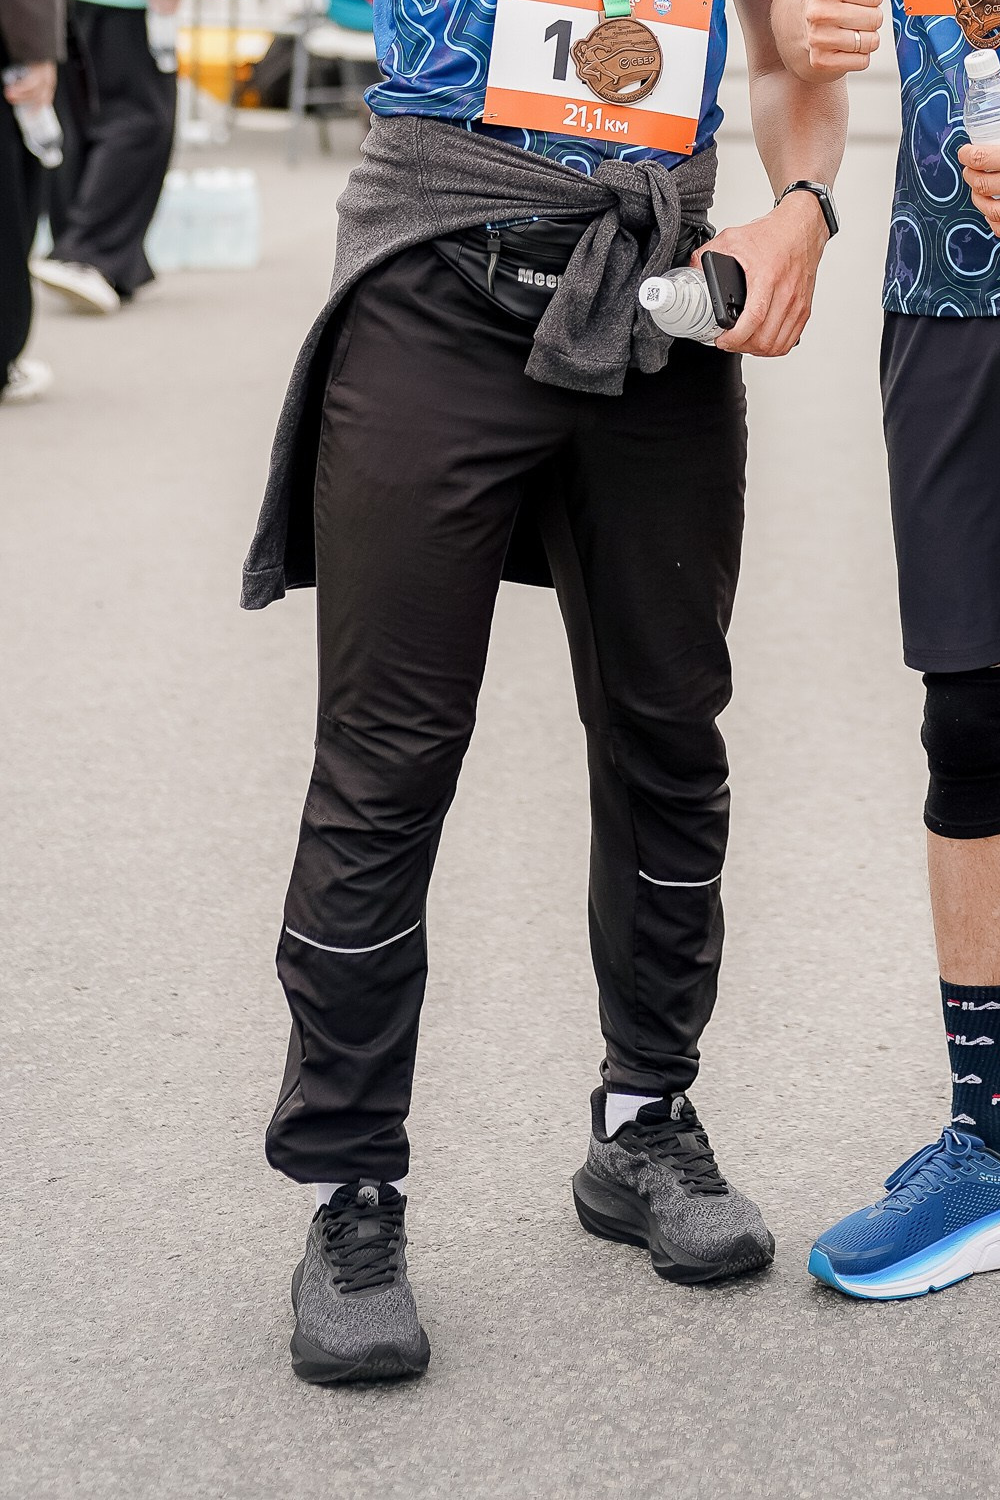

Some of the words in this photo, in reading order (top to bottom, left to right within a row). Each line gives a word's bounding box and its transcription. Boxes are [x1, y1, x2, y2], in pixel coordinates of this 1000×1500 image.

[630, 56, 656, 67] СБЕР
[946, 1031, 995, 1046] FILA
[952, 1072, 983, 1084] ILA
